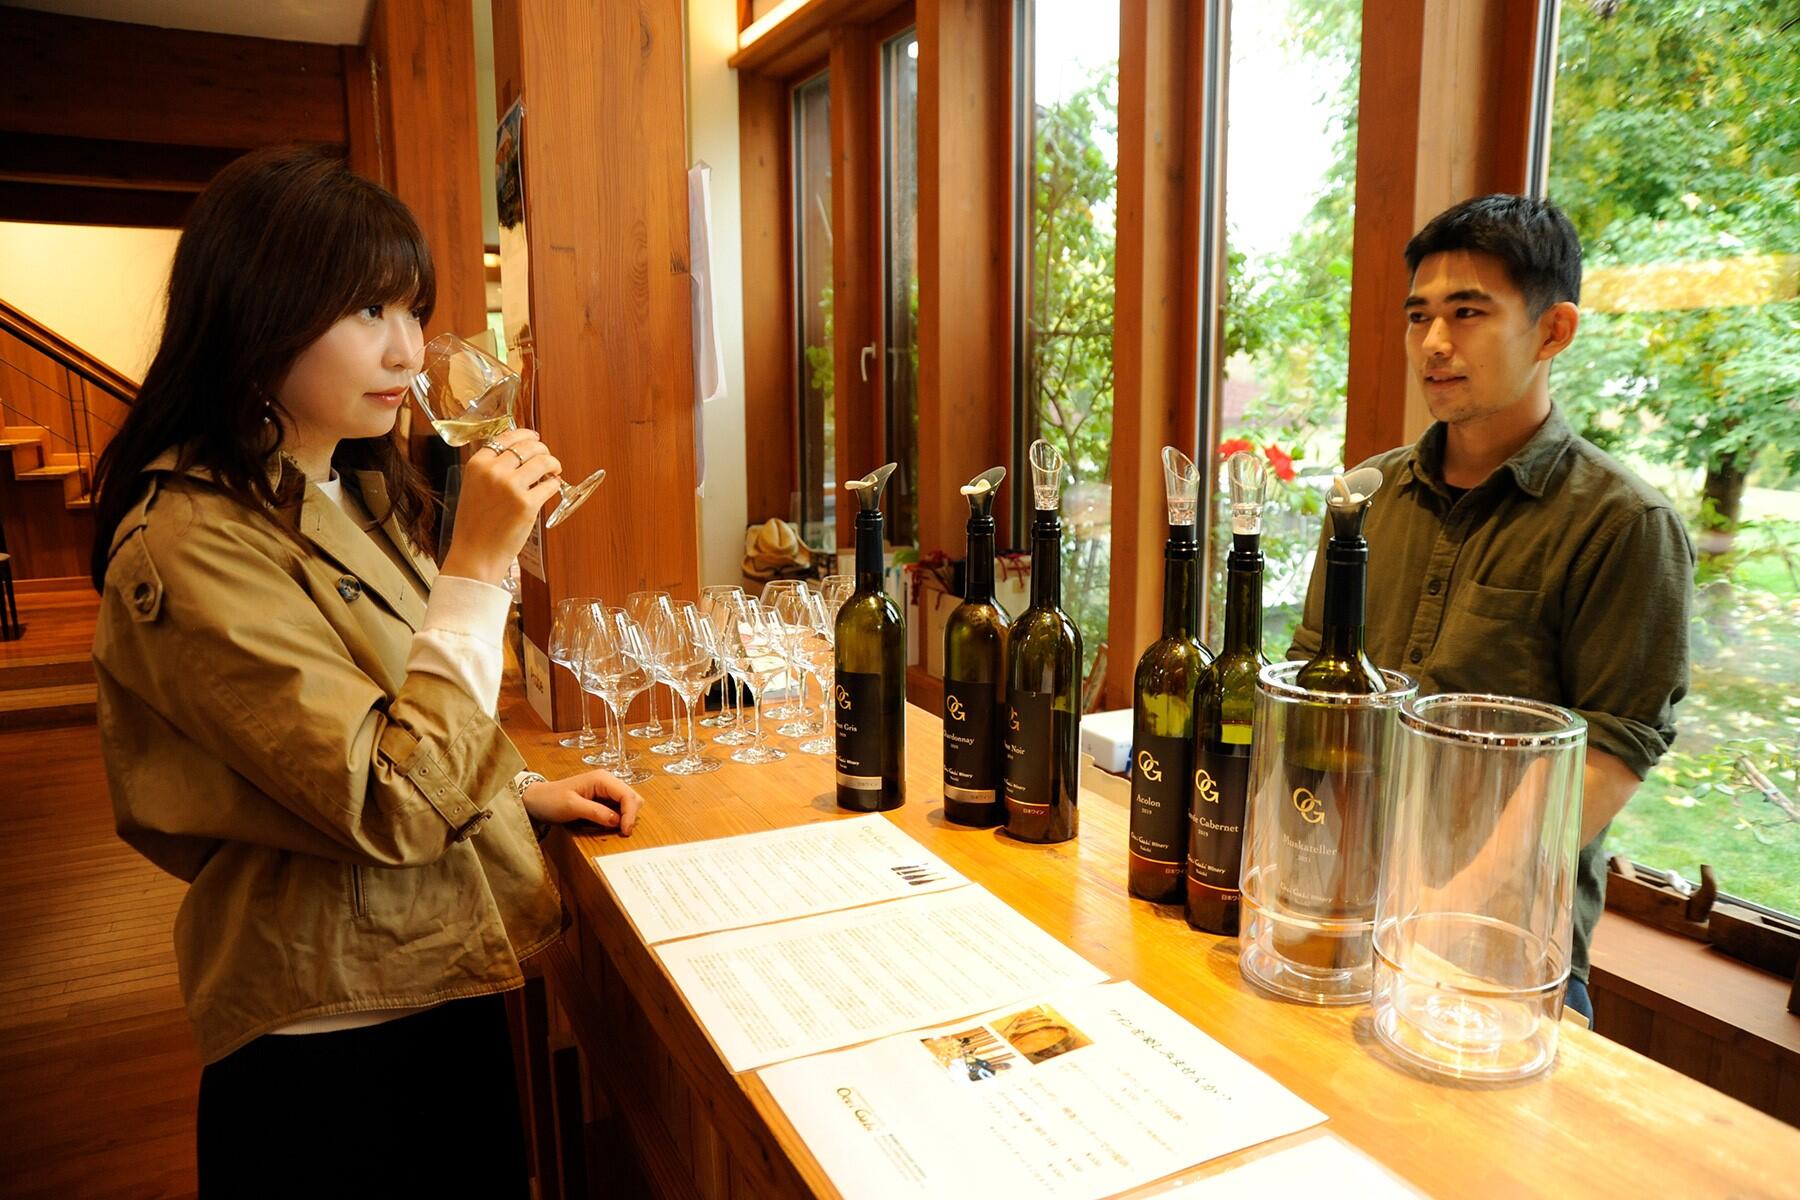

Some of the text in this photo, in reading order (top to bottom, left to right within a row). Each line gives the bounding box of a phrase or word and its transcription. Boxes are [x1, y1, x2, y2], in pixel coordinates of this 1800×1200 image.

[836, 684, 852, 711] OG
[947, 694, 966, 722] OG
[844, 722, 858, 733] Gris
[1138, 750, 1162, 782] OG
[1195, 768, 1219, 804] OG
[1136, 793, 1161, 808] Acolon
[1293, 786, 1326, 825] OG
[1199, 816, 1239, 833] Cabernet
[1282, 833, 1338, 856] Muskateller
[1165, 867, 1185, 875] 日本ワイ
